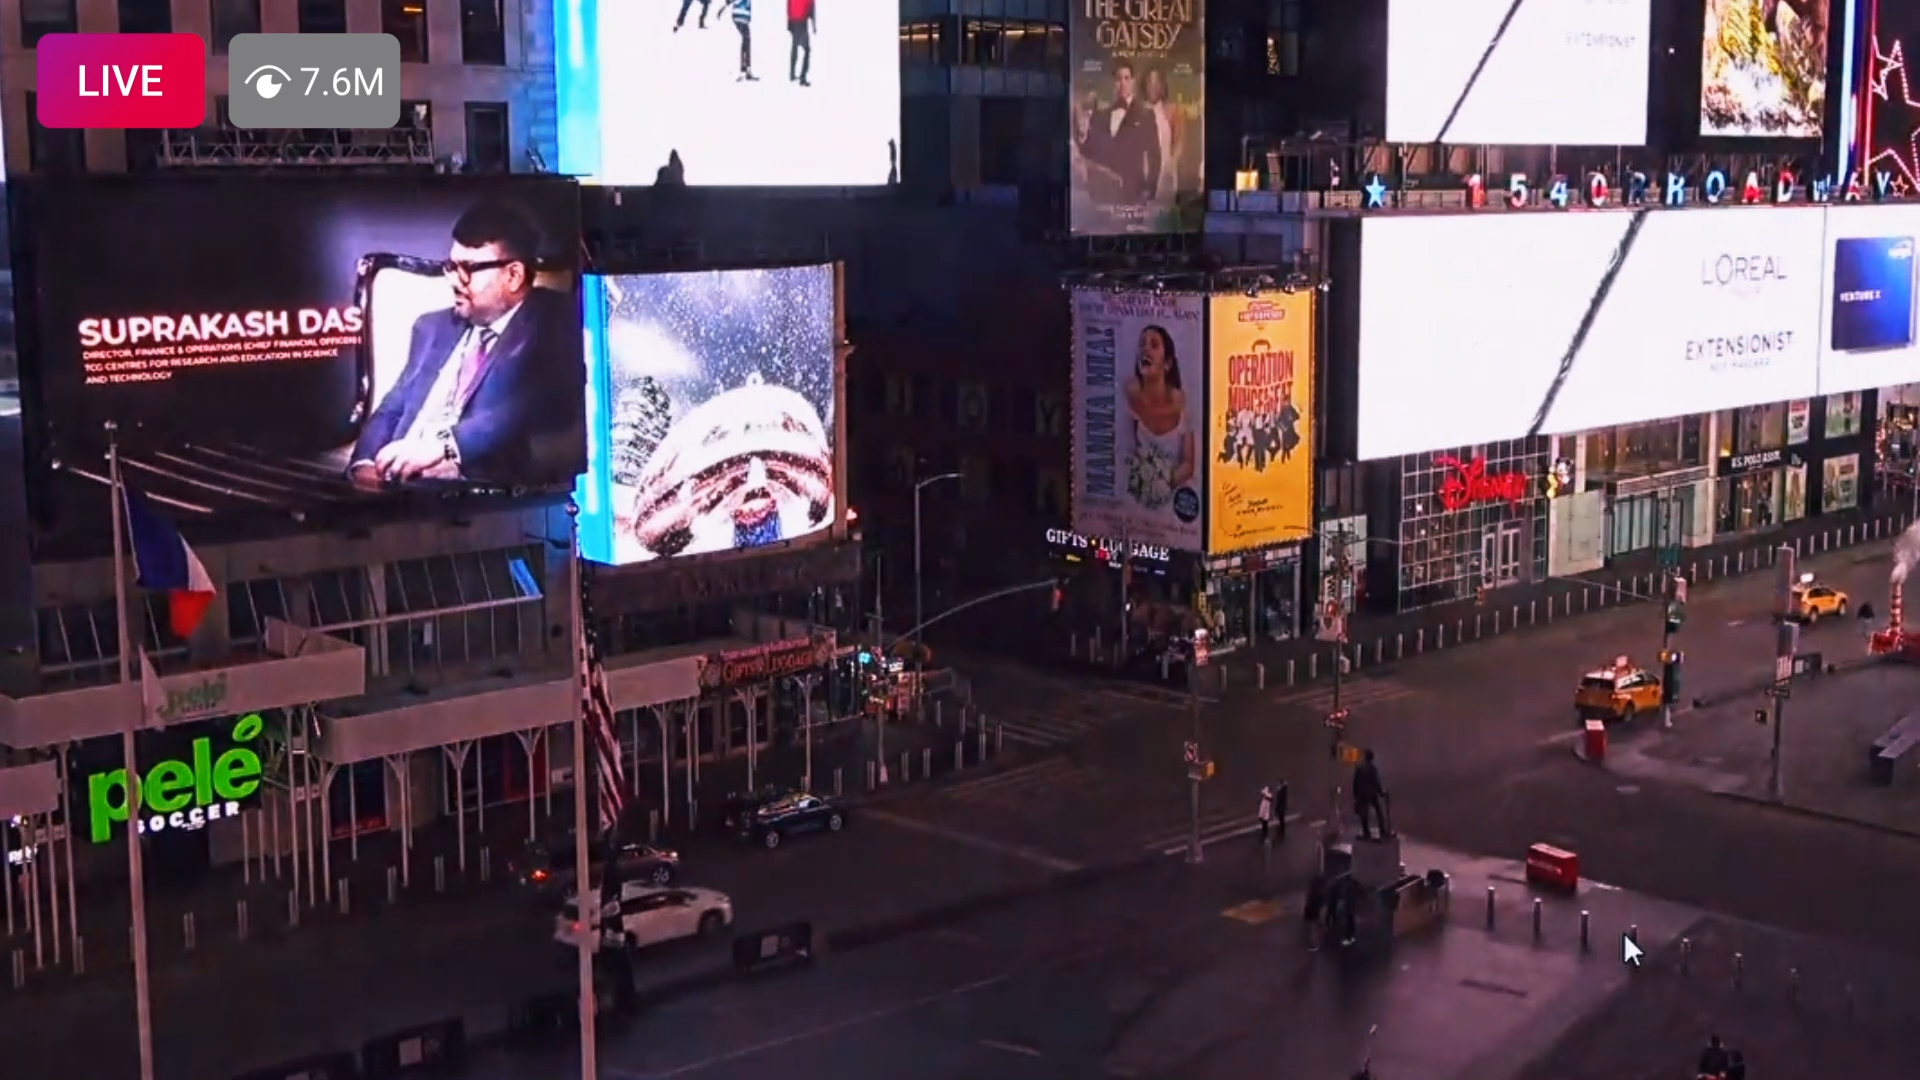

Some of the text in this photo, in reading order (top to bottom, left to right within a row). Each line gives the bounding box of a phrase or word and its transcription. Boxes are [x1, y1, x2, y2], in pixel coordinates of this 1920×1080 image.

[1085, 0, 1192, 21] THE GREAT
[1096, 21, 1182, 48] GATSBY
[79, 306, 363, 346] SUPRAKASH DAS
[105, 360, 147, 371] CENTRES
[150, 358, 168, 369] FOR
[171, 356, 219, 367] RESEARCH
[220, 354, 240, 363] AND
[241, 350, 291, 362] EDUCATION
[292, 350, 302, 359] IN
[303, 348, 338, 358] SCIENCE
[135, 346, 175, 356] FINANCE
[177, 346, 183, 354] &
[185, 342, 241, 353] OPERATIONS
[274, 338, 317, 349] FINANCIAL
[1086, 326, 1115, 386] MIA!
[1686, 331, 1794, 361] EXTENSIONIST
[85, 372, 172, 384] AND TECHNOLOGY
[1228, 350, 1294, 385] OPERATION
[1086, 395, 1115, 496] MAMMA
[1744, 453, 1761, 467] POLO
[1046, 528, 1088, 548] GIFTS
[89, 713, 263, 844] pelé
[137, 801, 240, 834] SOCCER
